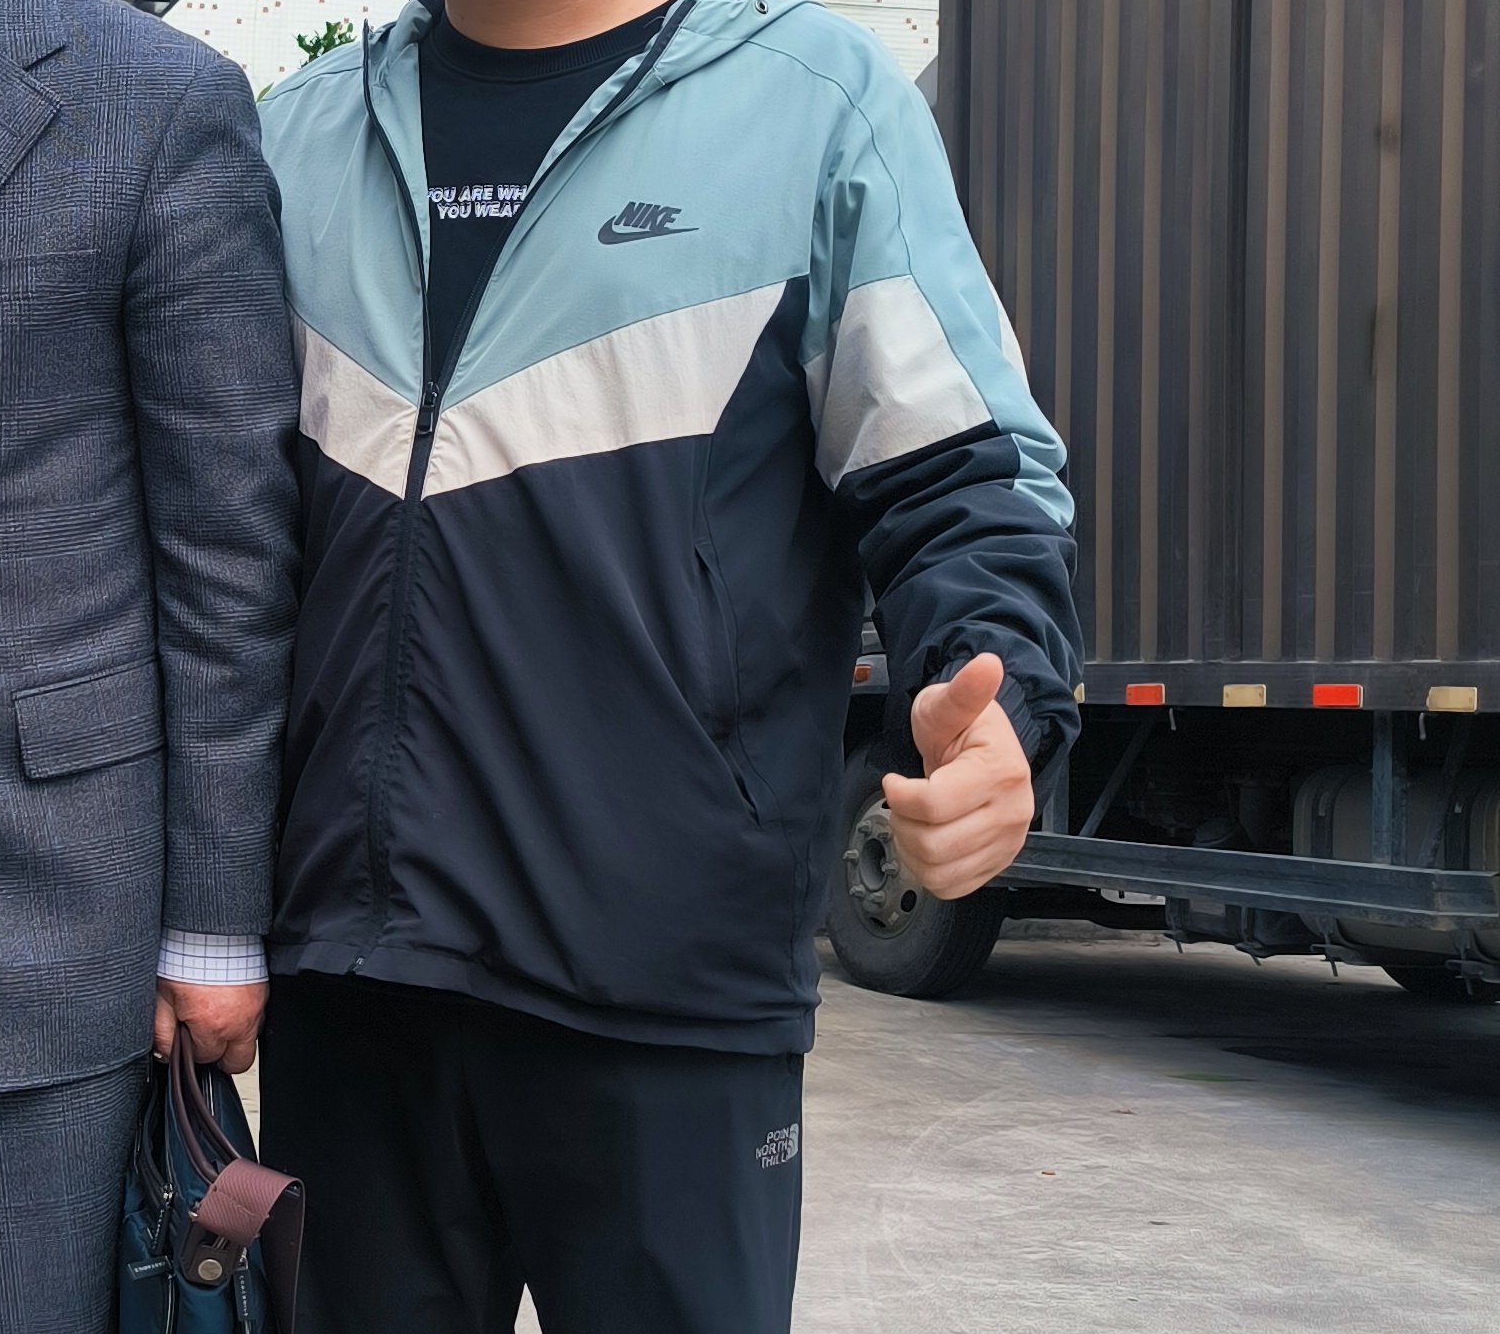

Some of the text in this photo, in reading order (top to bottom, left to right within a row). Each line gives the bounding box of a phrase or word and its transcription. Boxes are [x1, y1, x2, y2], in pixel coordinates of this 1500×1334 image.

[458, 185, 494, 202] ARE
[437, 202, 472, 219] YOU
[613, 201, 683, 231] NIKE
